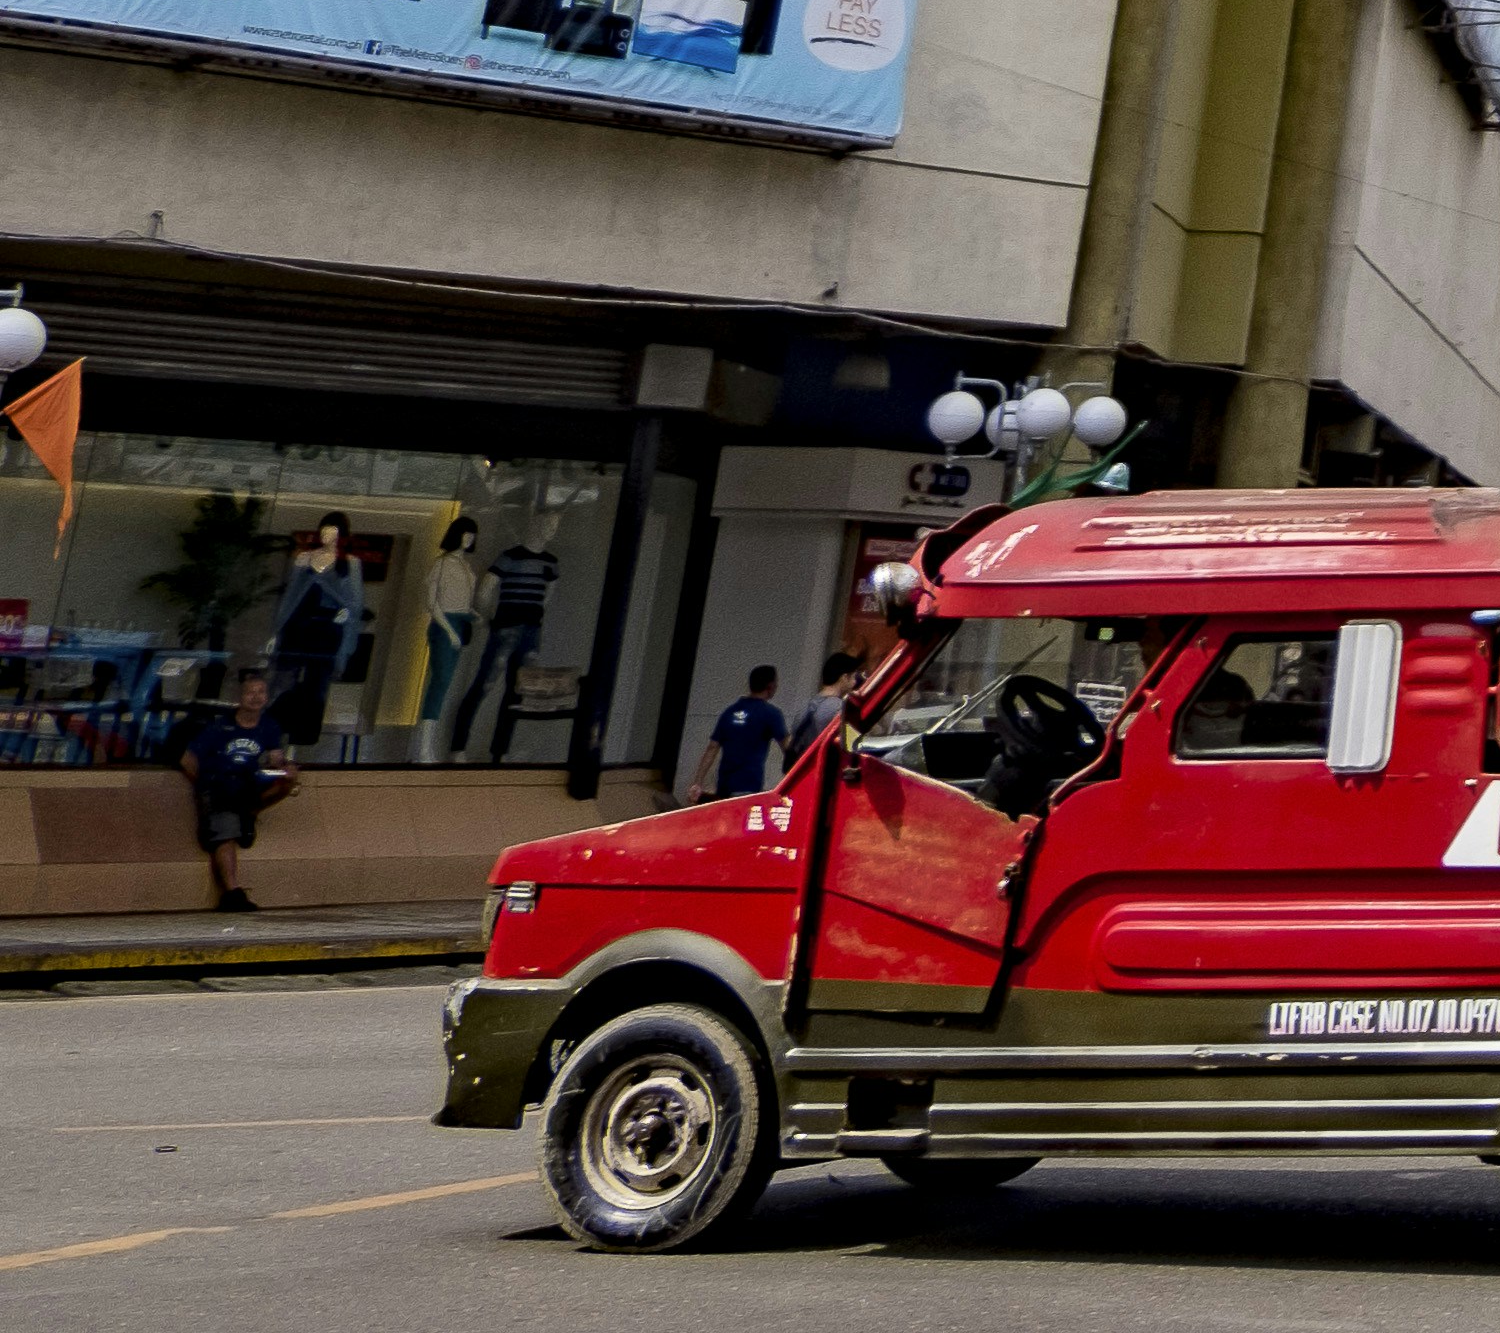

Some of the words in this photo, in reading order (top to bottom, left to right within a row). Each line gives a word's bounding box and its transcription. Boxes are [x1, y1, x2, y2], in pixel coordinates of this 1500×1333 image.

[825, 11, 883, 39] LESS
[1268, 1000, 1327, 1036] LTFRB
[1327, 999, 1379, 1035] CASE
